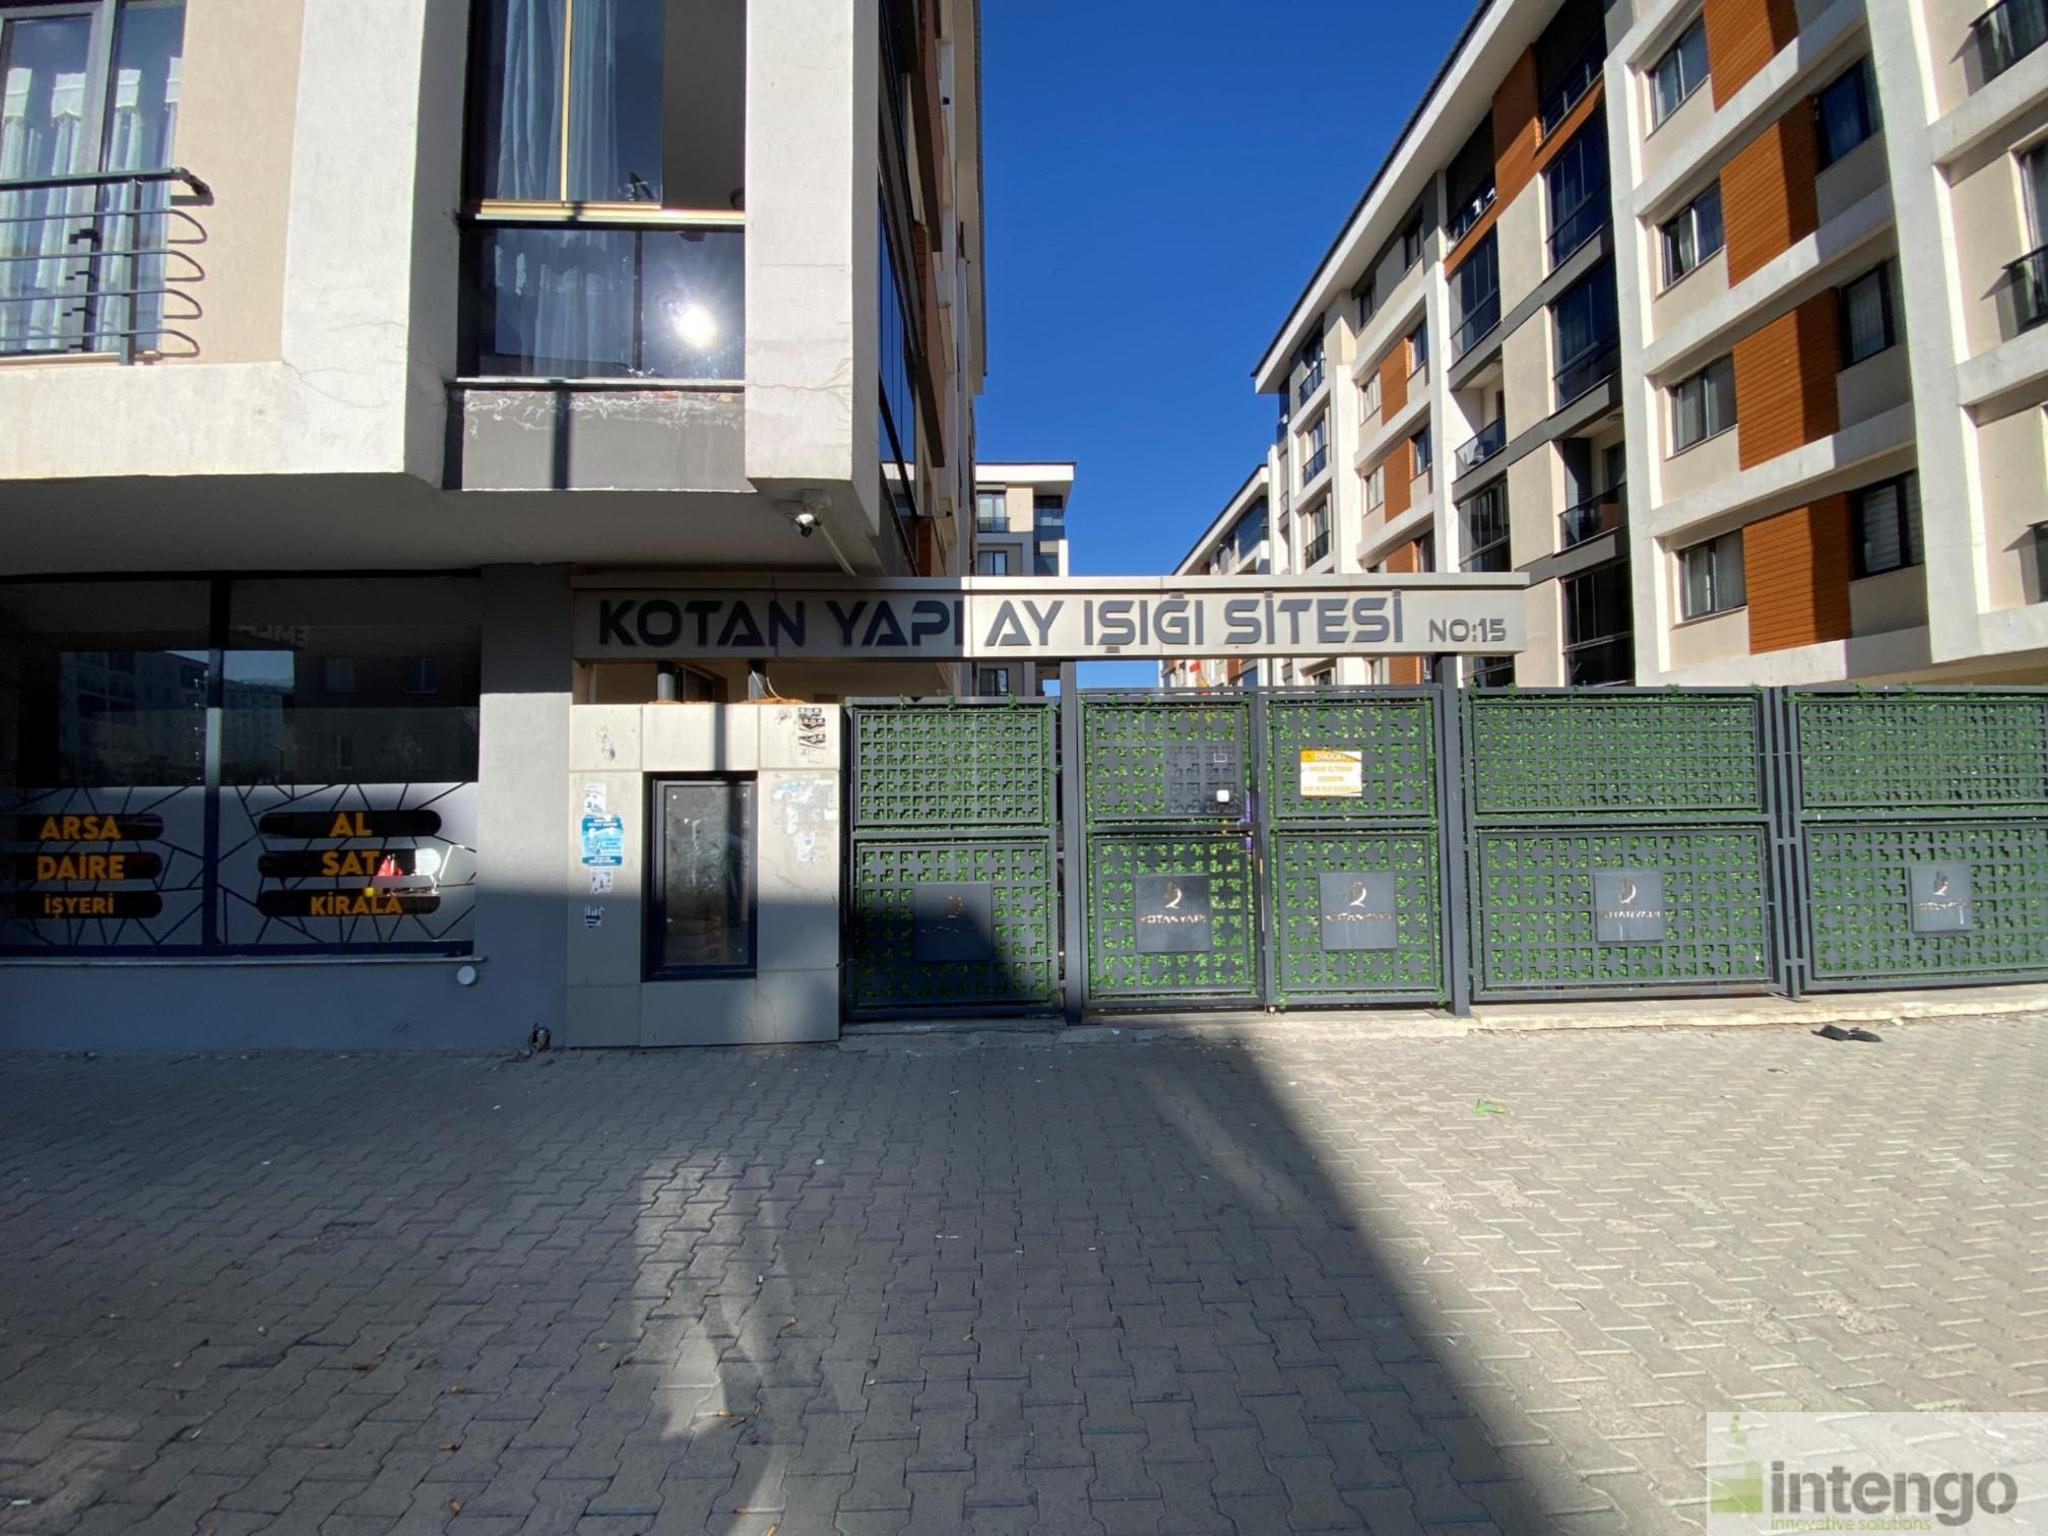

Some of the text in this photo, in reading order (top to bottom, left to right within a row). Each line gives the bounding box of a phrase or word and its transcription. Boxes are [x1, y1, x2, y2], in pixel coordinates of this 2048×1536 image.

[600, 599, 806, 647] KOTAN
[824, 599, 964, 647] YAPI
[984, 599, 1064, 647] AY
[1224, 588, 1404, 645] SİTESİ
[1428, 617, 1508, 643] NO:15
[39, 815, 122, 840] ARSA
[329, 812, 373, 837] AL
[37, 852, 125, 881] DAİRE
[321, 850, 380, 876] SAT
[44, 893, 115, 919] İŞYERİ
[310, 892, 403, 916] KİRALA
